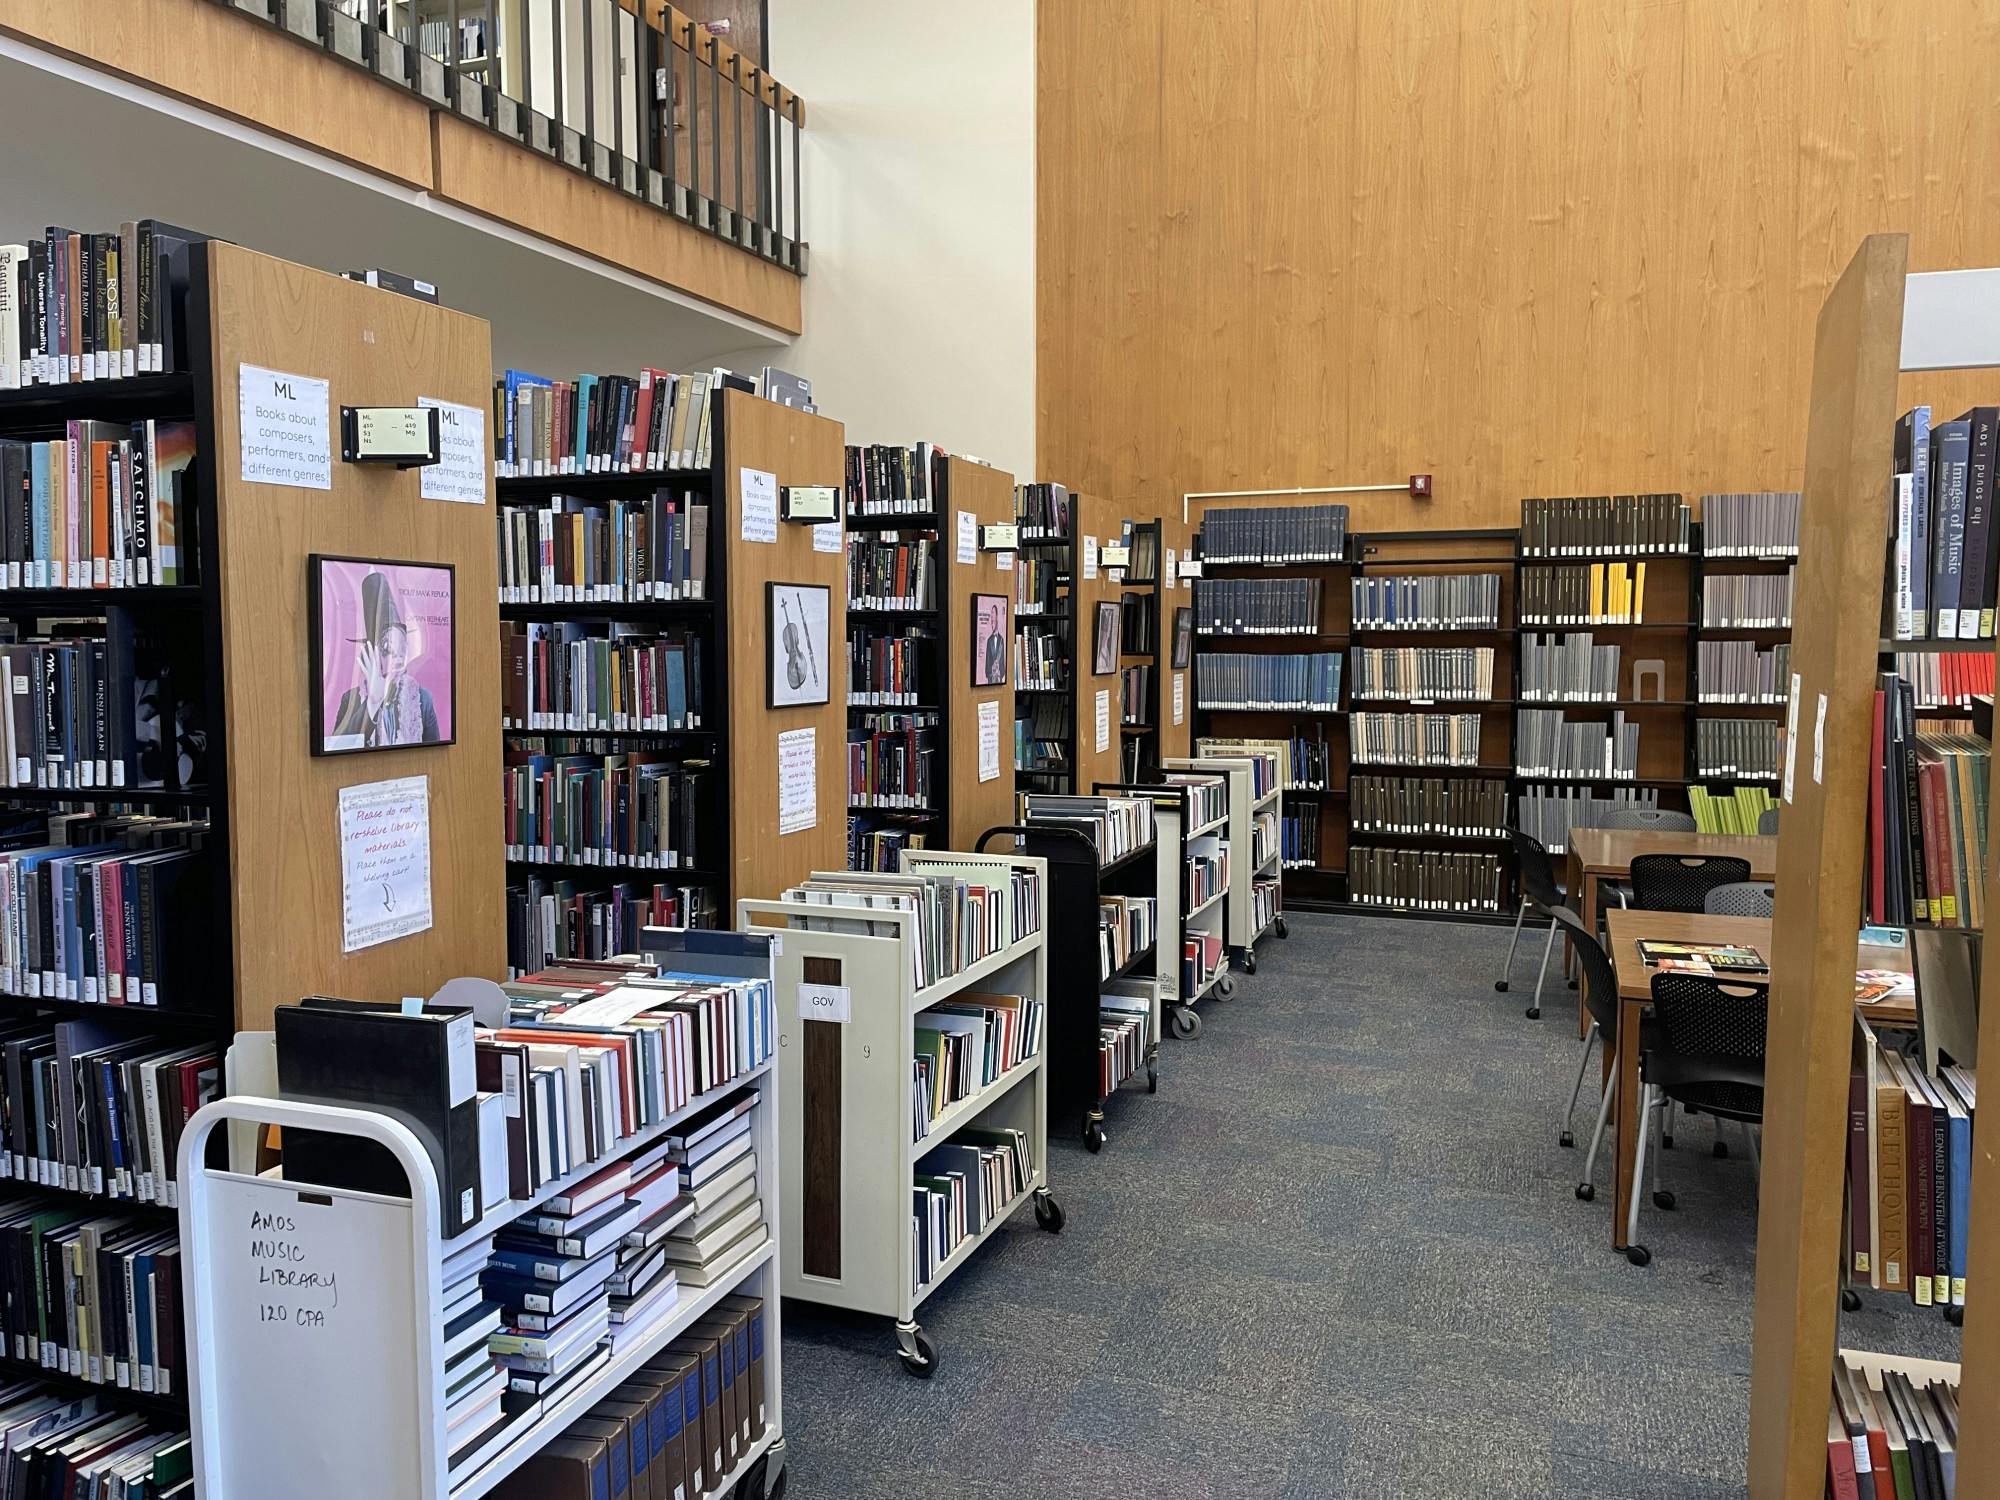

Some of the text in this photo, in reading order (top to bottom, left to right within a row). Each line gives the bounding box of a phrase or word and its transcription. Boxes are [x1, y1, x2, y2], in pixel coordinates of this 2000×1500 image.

[96, 258, 105, 284] Alma
[107, 279, 118, 319] ROSE
[139, 287, 150, 330] Starker
[39, 316, 47, 351] Tonality
[274, 382, 296, 400] ML
[256, 406, 316, 426] Books about
[442, 410, 459, 426] ML
[260, 428, 314, 446] composers,
[453, 436, 474, 448] about
[1979, 424, 1988, 447] saw
[248, 445, 326, 463] performers, and
[1917, 447, 1926, 472] RENT
[248, 463, 291, 478] different
[468, 472, 482, 480] and
[754, 475, 763, 486] ML
[424, 481, 456, 493] different
[1974, 464, 1985, 500] sound
[134, 452, 146, 548] SATCHMO
[1917, 486, 1925, 515] JONATHAN
[1948, 462, 1965, 574] Images of Music
[1970, 507, 1982, 524] the
[637, 549, 645, 576] VIOLIN
[47, 682, 55, 732] Trumpet
[1907, 749, 1916, 778] OCTET
[1908, 781, 1917, 797] FOR
[357, 802, 412, 822] Please do not
[1910, 801, 1919, 836] STRINGS
[350, 822, 420, 840] re-shelve library
[357, 861, 376, 870] Place
[1916, 875, 1922, 883] OF
[104, 870, 114, 949] MAKEUP BREAKUP
[812, 996, 834, 1006] GOV
[864, 1044, 870, 1058] 9
[109, 1110, 118, 1141] Drummond
[1918, 1158, 1927, 1178] VAN
[1881, 1109, 1902, 1263] BEETHOVEN
[1919, 1179, 1928, 1229] BEETHOVEN
[1935, 1128, 1946, 1270] LEONARD BERNSTEIN AT WORK
[251, 1210, 295, 1232] AMOS
[516, 1218, 536, 1227] Rossini
[252, 1240, 304, 1262] MUSIC
[260, 1266, 338, 1308] LIBRARY
[261, 1304, 324, 1327] 120 CPA
